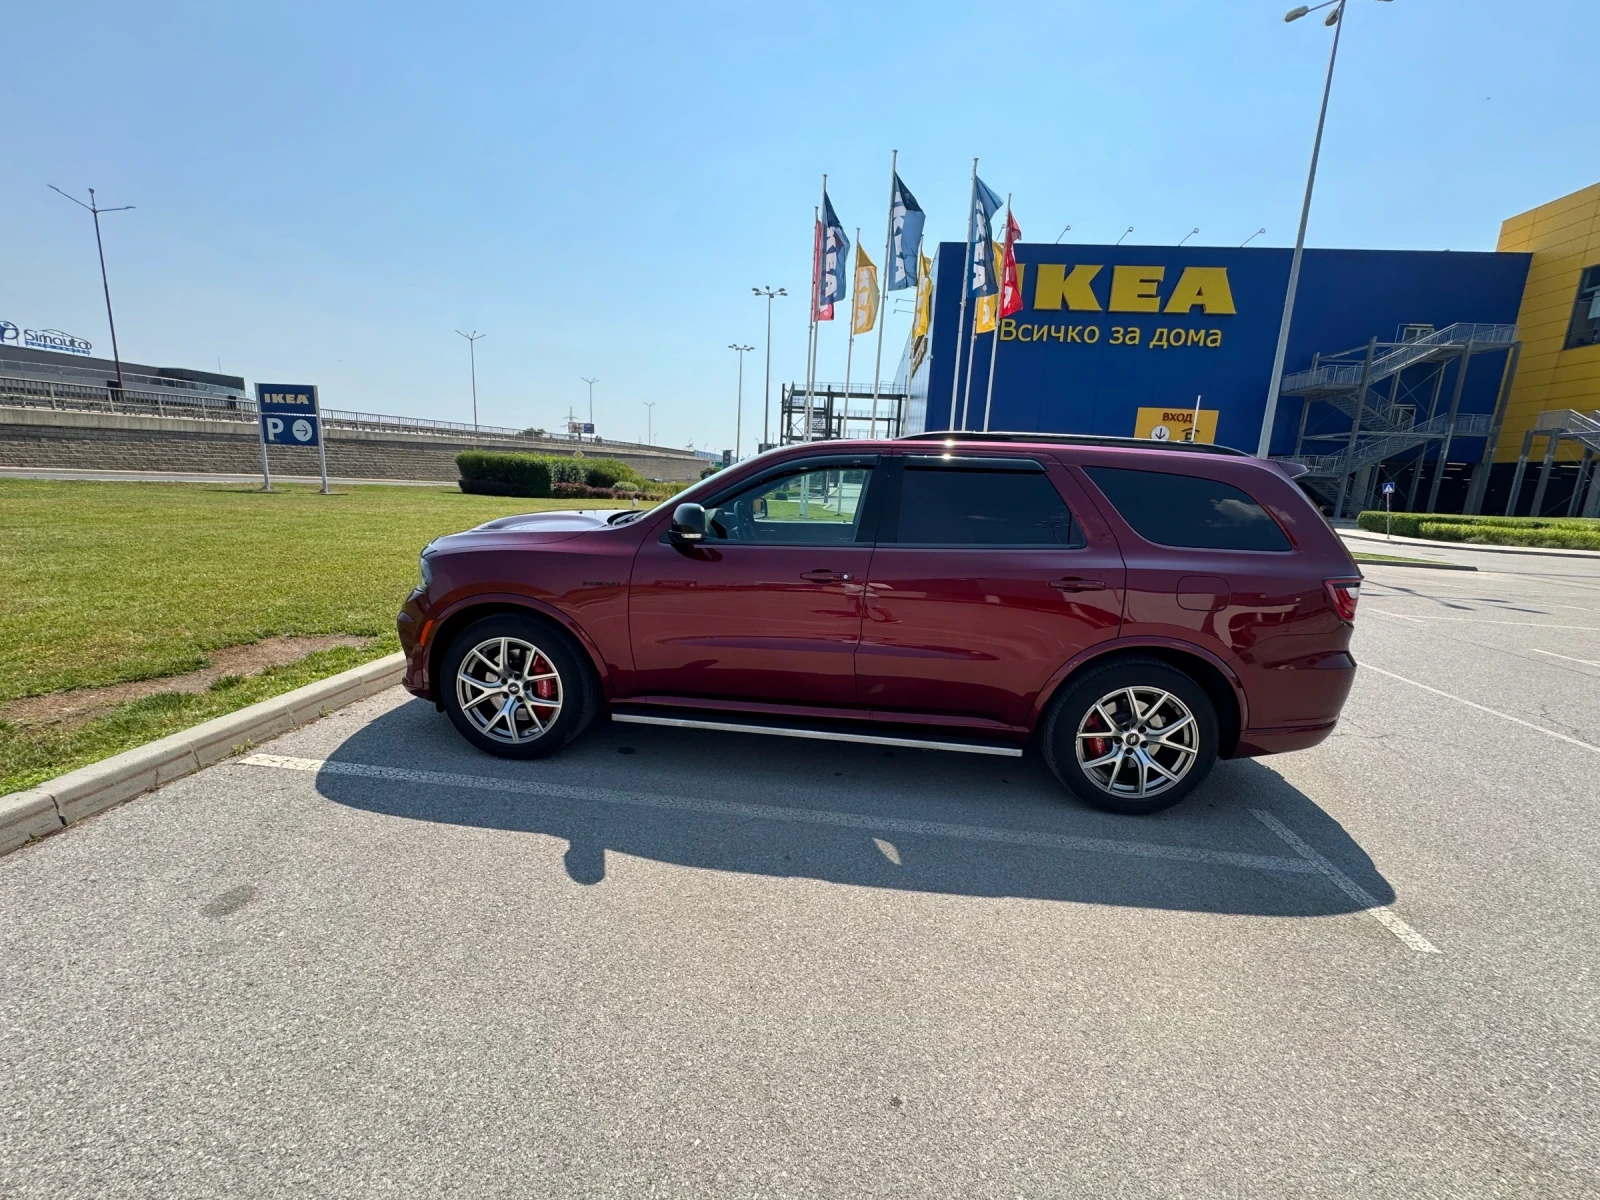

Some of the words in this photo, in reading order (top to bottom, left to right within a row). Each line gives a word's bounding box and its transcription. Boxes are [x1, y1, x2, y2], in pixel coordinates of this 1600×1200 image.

[24, 329, 90, 350] Simauto
[999, 318, 1100, 344] Всичко
[1109, 326, 1141, 345] за
[1149, 327, 1222, 349] дома
[264, 393, 309, 405] IKEA
[1162, 412, 1192, 423] ВХОД
[266, 417, 284, 440] P
